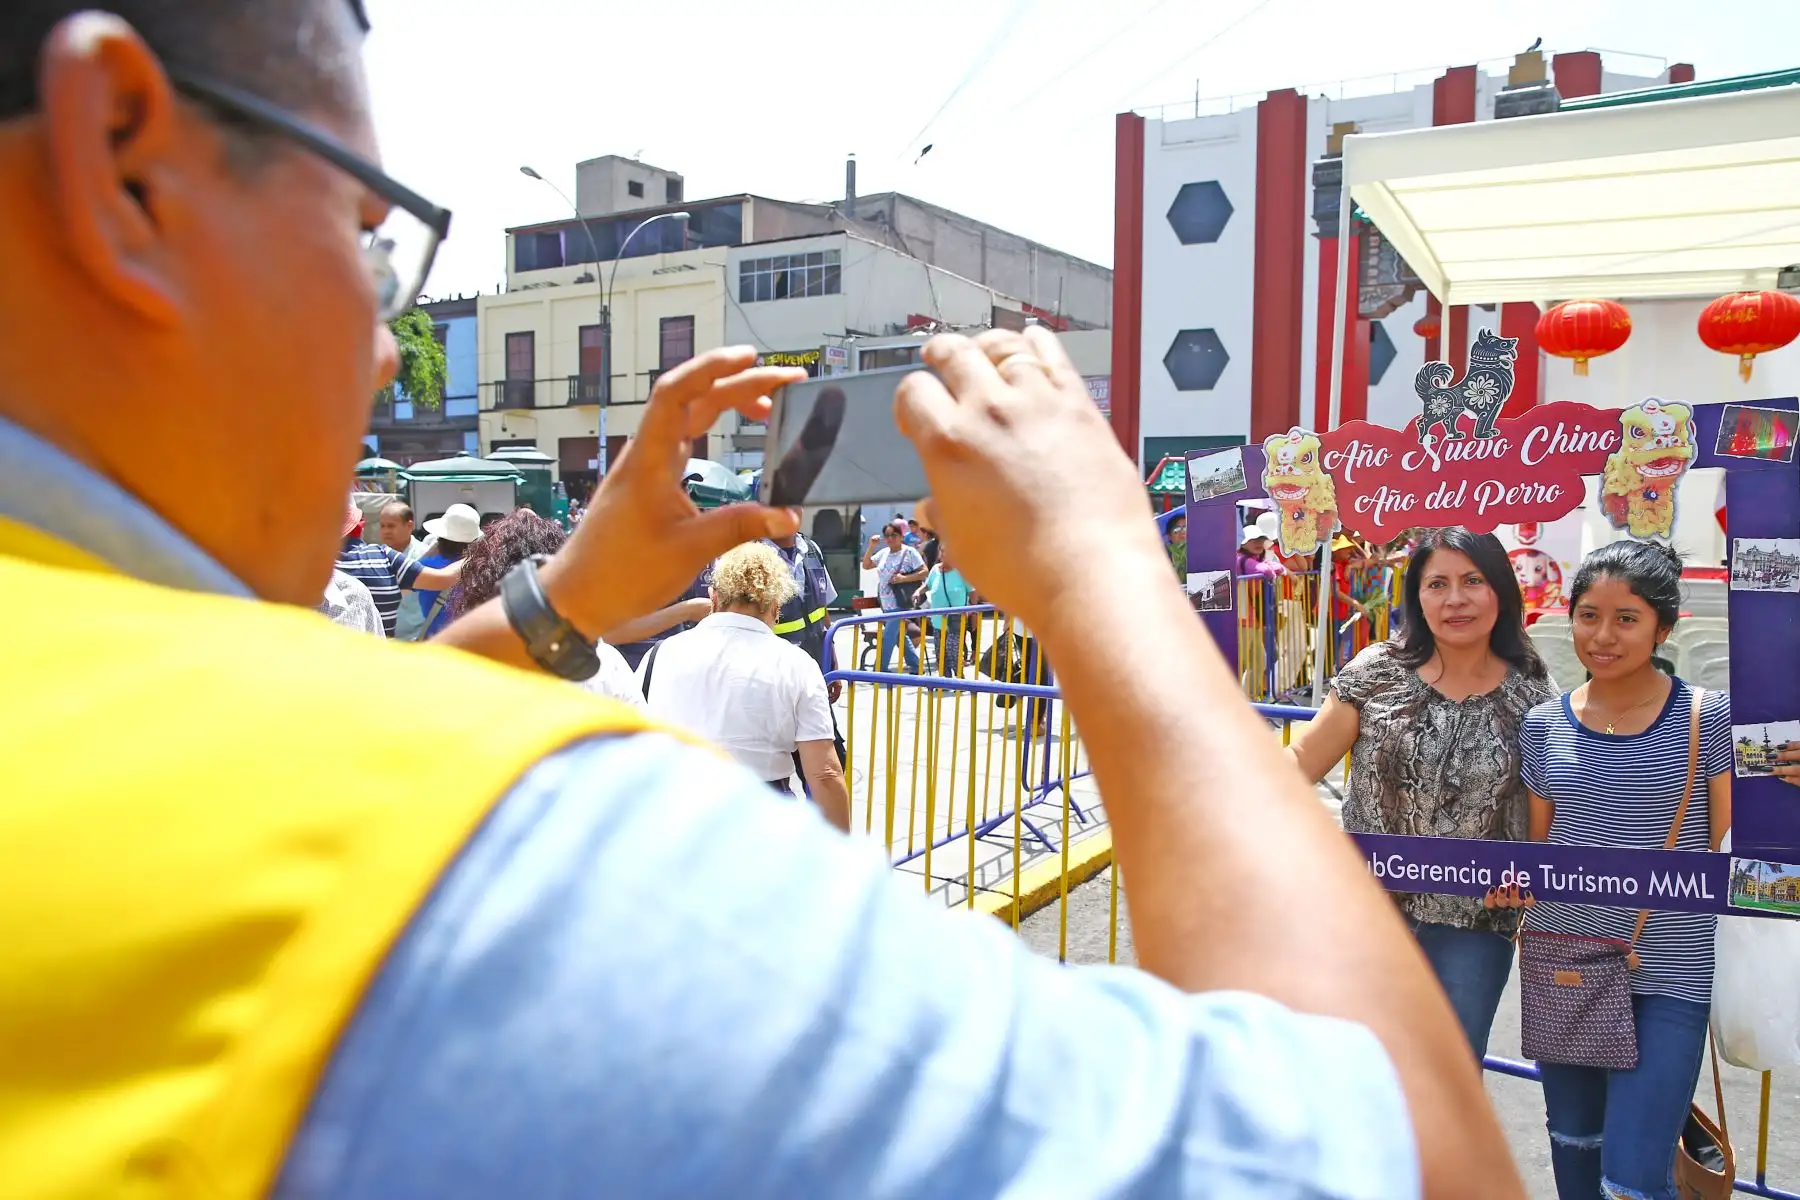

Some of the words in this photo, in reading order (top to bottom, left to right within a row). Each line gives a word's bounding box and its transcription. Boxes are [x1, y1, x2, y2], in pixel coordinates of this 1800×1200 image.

[1323, 440, 1392, 484] Año
[1401, 433, 1513, 472] Nuevo
[1520, 422, 1620, 466] Chino
[1354, 485, 1419, 527] Año
[1424, 479, 1467, 510] del
[1473, 479, 1565, 516] Perro
[1500, 861, 1531, 888] de
[1538, 864, 1639, 895] Turismo
[1648, 870, 1715, 899] MML
